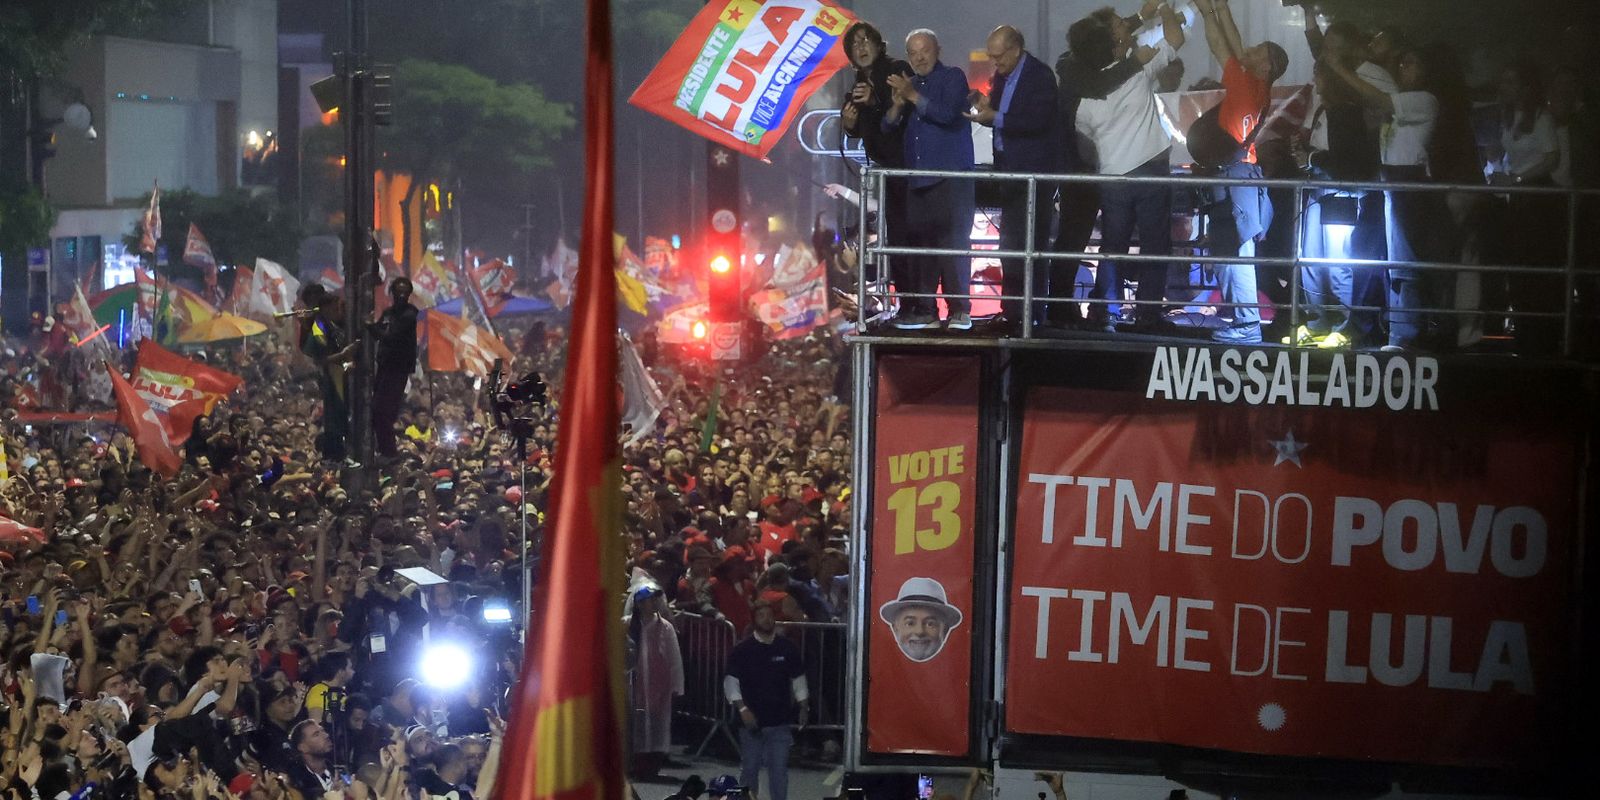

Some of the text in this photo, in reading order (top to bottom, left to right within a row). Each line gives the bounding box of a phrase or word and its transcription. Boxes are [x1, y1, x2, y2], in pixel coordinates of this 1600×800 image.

[815, 10, 839, 30] 13
[704, 6, 805, 132] LULA
[753, 31, 822, 125] VICE ALCKMIN
[1146, 346, 1439, 411] AVASSALADOR
[888, 445, 965, 484] VOTE
[887, 480, 961, 555] 13
[1028, 473, 1548, 578] TIME DO POVO
[1021, 586, 1535, 695] TIME DE LULA
